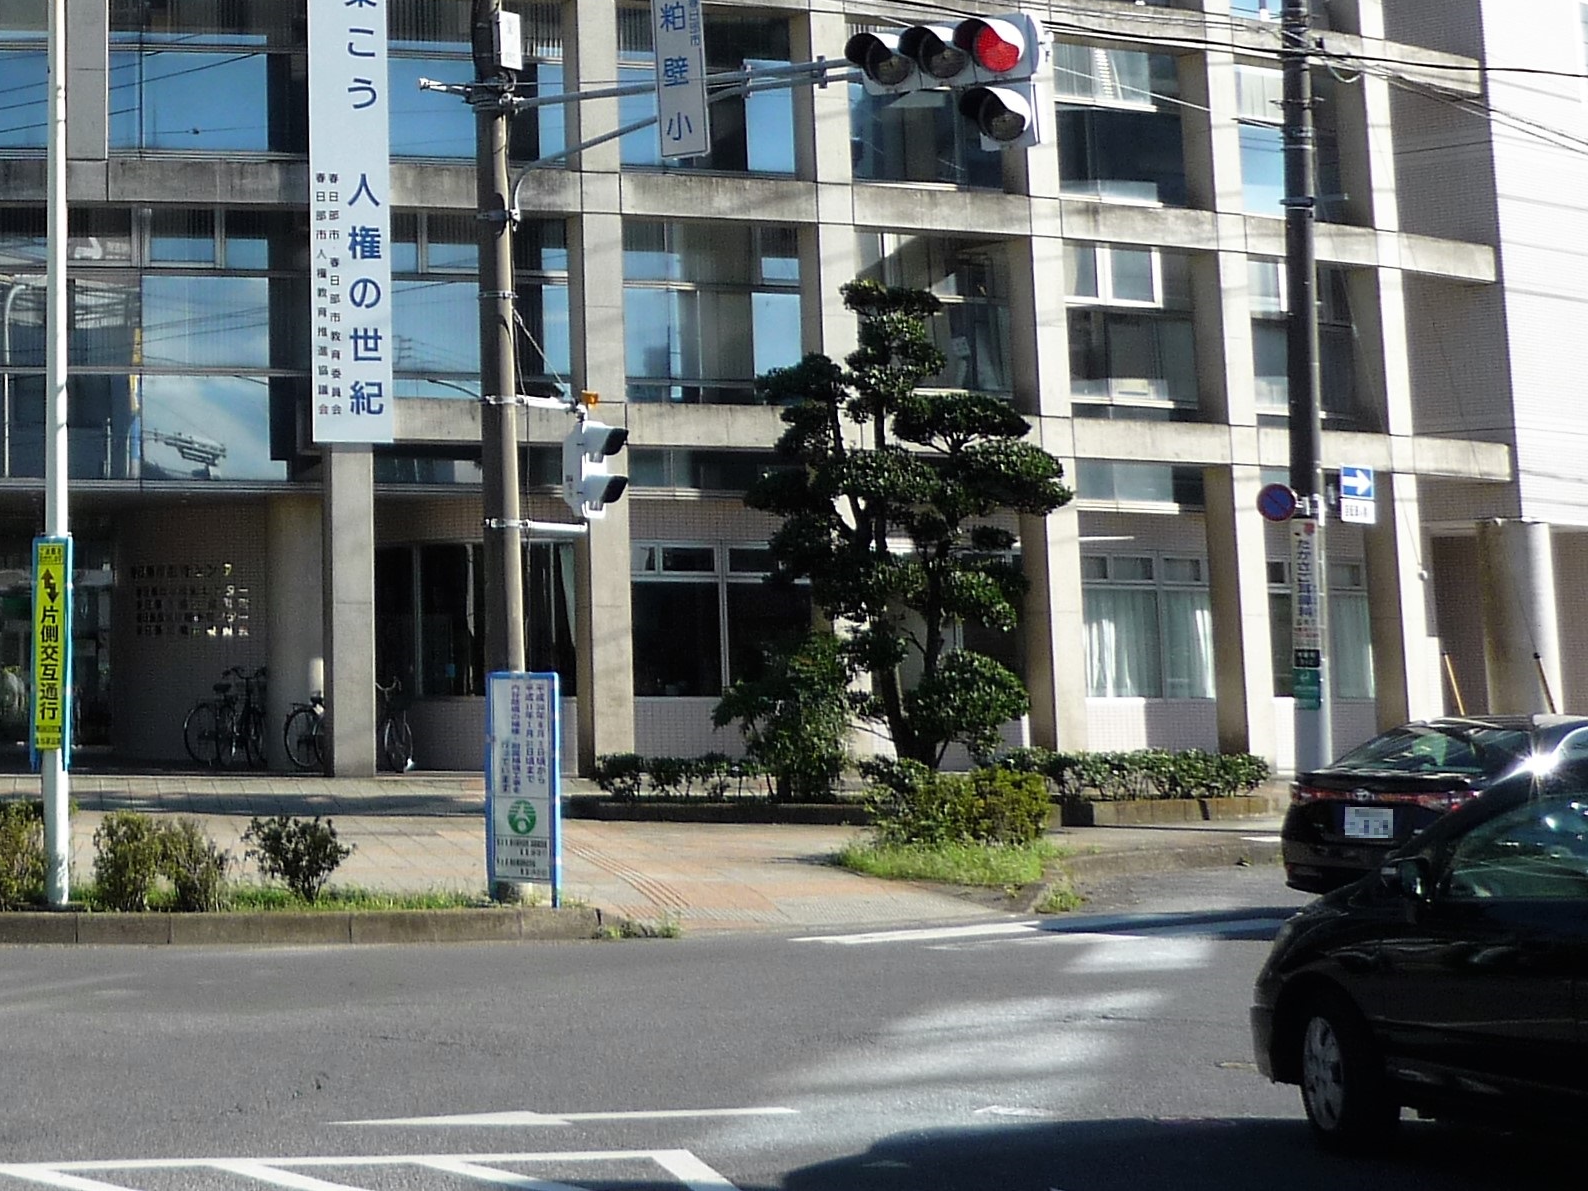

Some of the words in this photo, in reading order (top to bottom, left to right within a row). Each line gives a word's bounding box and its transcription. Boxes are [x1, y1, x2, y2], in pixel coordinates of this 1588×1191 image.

[660, 1, 692, 140] 粕壁小
[348, 173, 384, 416] 人権の世紀
[40, 605, 59, 720] 片側交互通行
